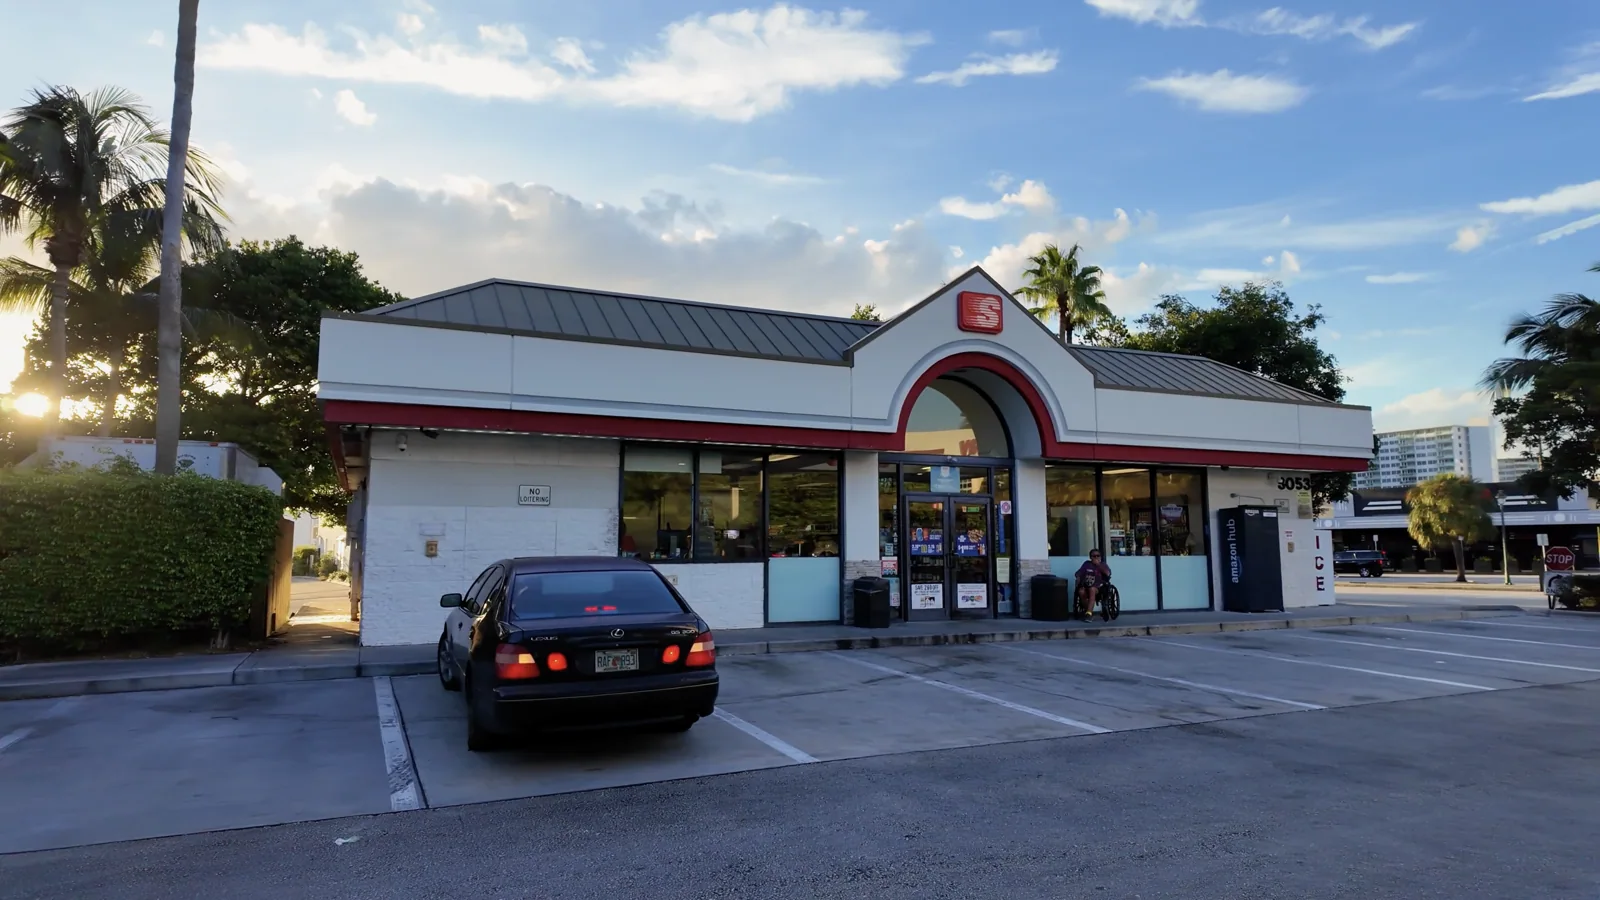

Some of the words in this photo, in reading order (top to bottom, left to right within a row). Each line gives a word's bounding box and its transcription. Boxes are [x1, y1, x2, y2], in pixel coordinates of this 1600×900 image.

[1277, 476, 1311, 490] 3053
[1226, 519, 1236, 541] hub
[1230, 543, 1239, 583] amazon
[1314, 535, 1325, 591] ICE
[1546, 554, 1573, 564] STOP
